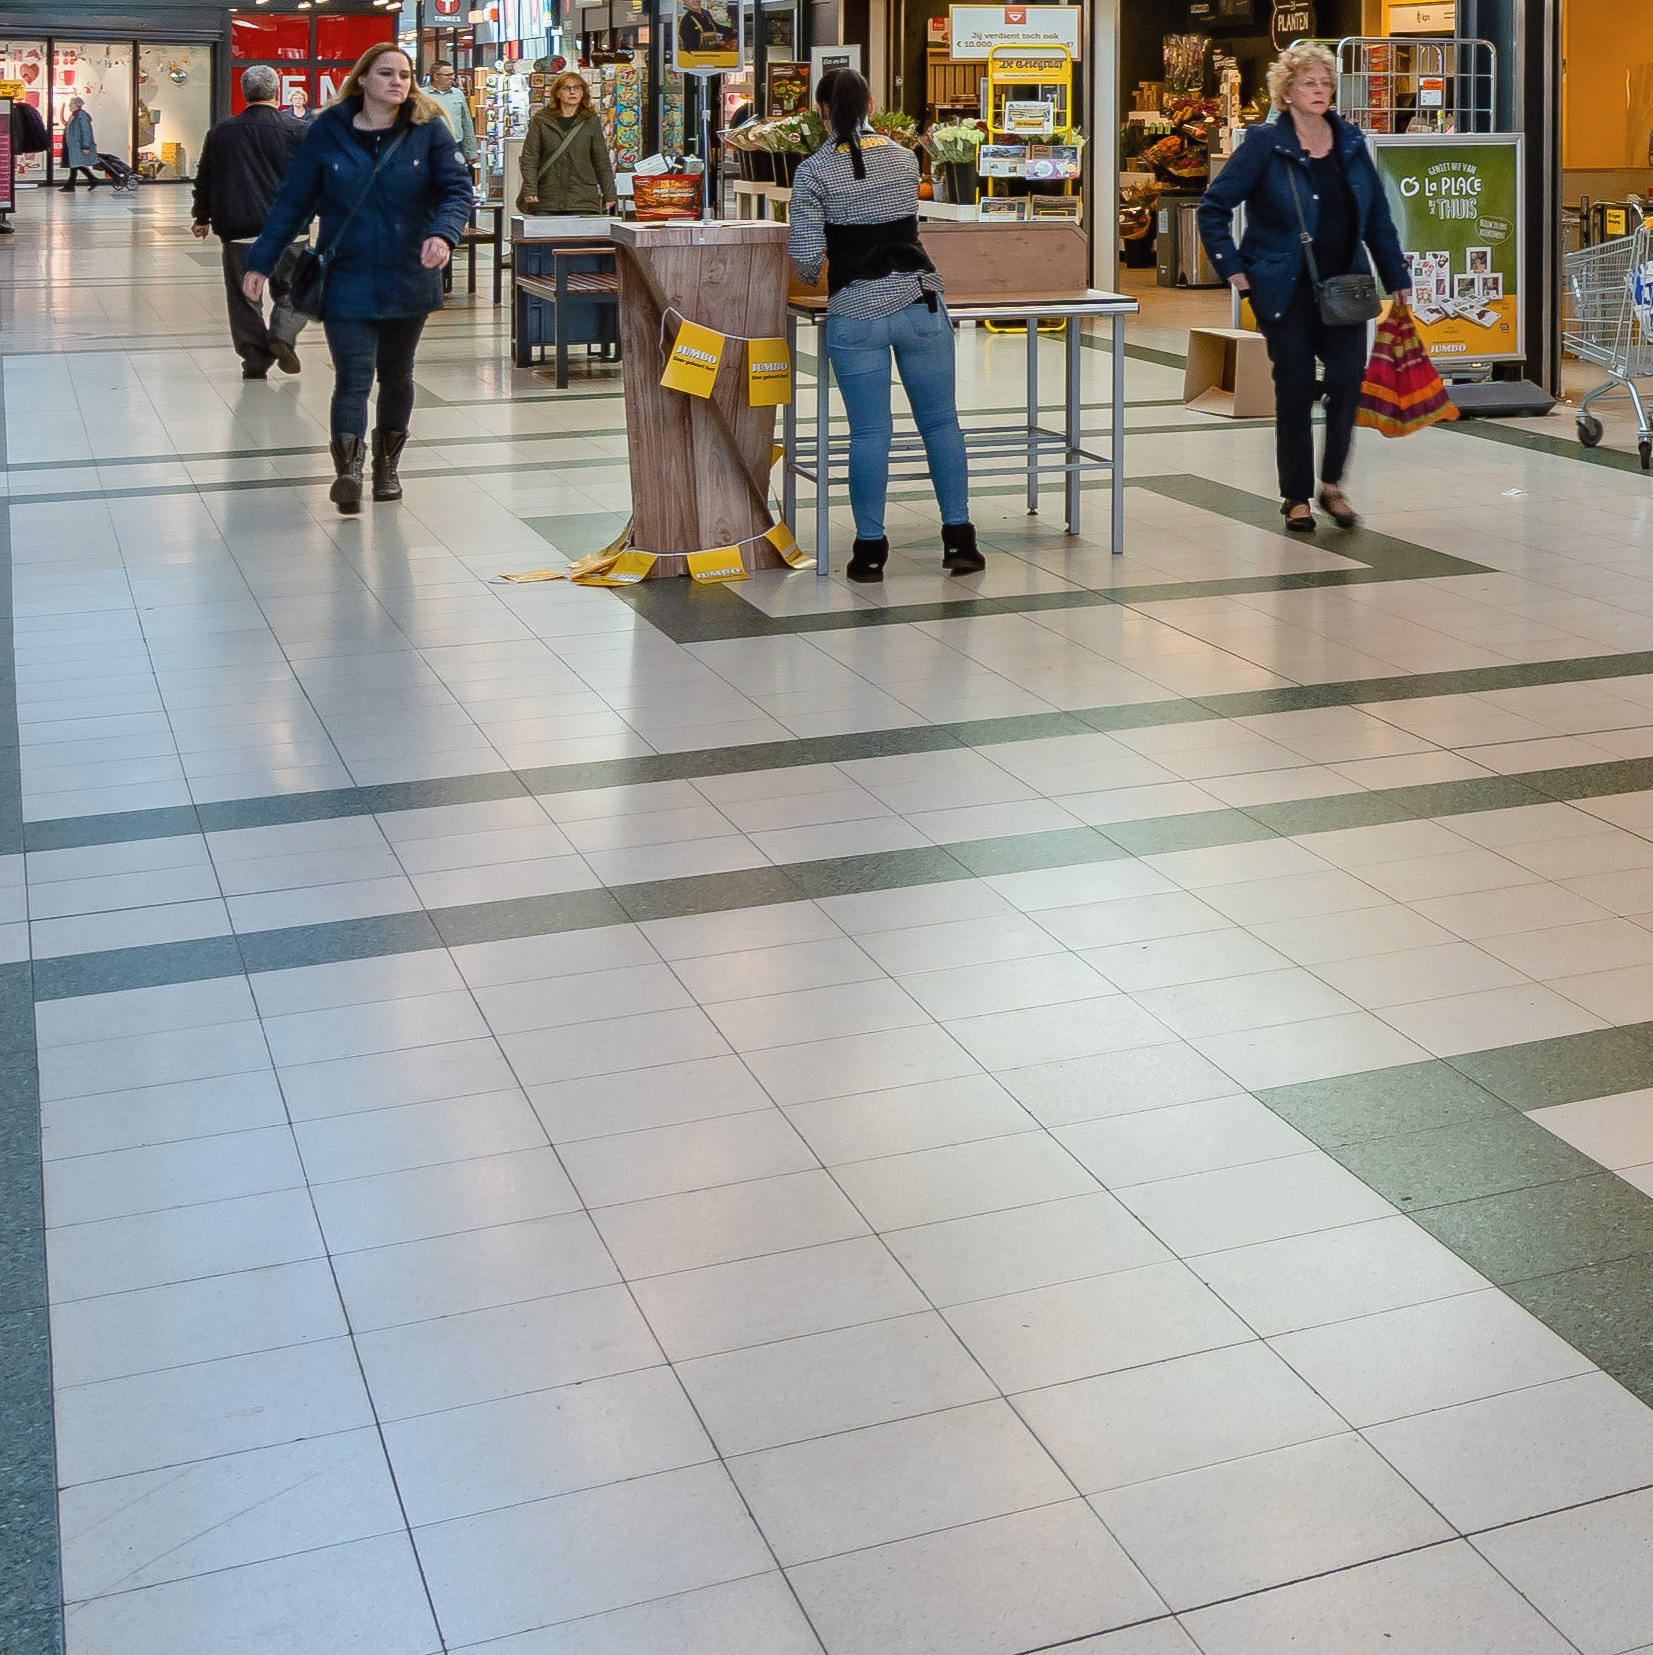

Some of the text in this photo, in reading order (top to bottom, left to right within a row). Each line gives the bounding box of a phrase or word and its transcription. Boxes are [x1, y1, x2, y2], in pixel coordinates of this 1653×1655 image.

[1278, 11, 1308, 32] PLANTEN
[1463, 163, 1477, 175] VAN
[1425, 176, 1482, 196] La PLACE
[1438, 198, 1477, 220] THUIS
[674, 344, 717, 365] JUMBO
[1430, 345, 1466, 354] JUMBO
[751, 362, 789, 373] JUMBO
